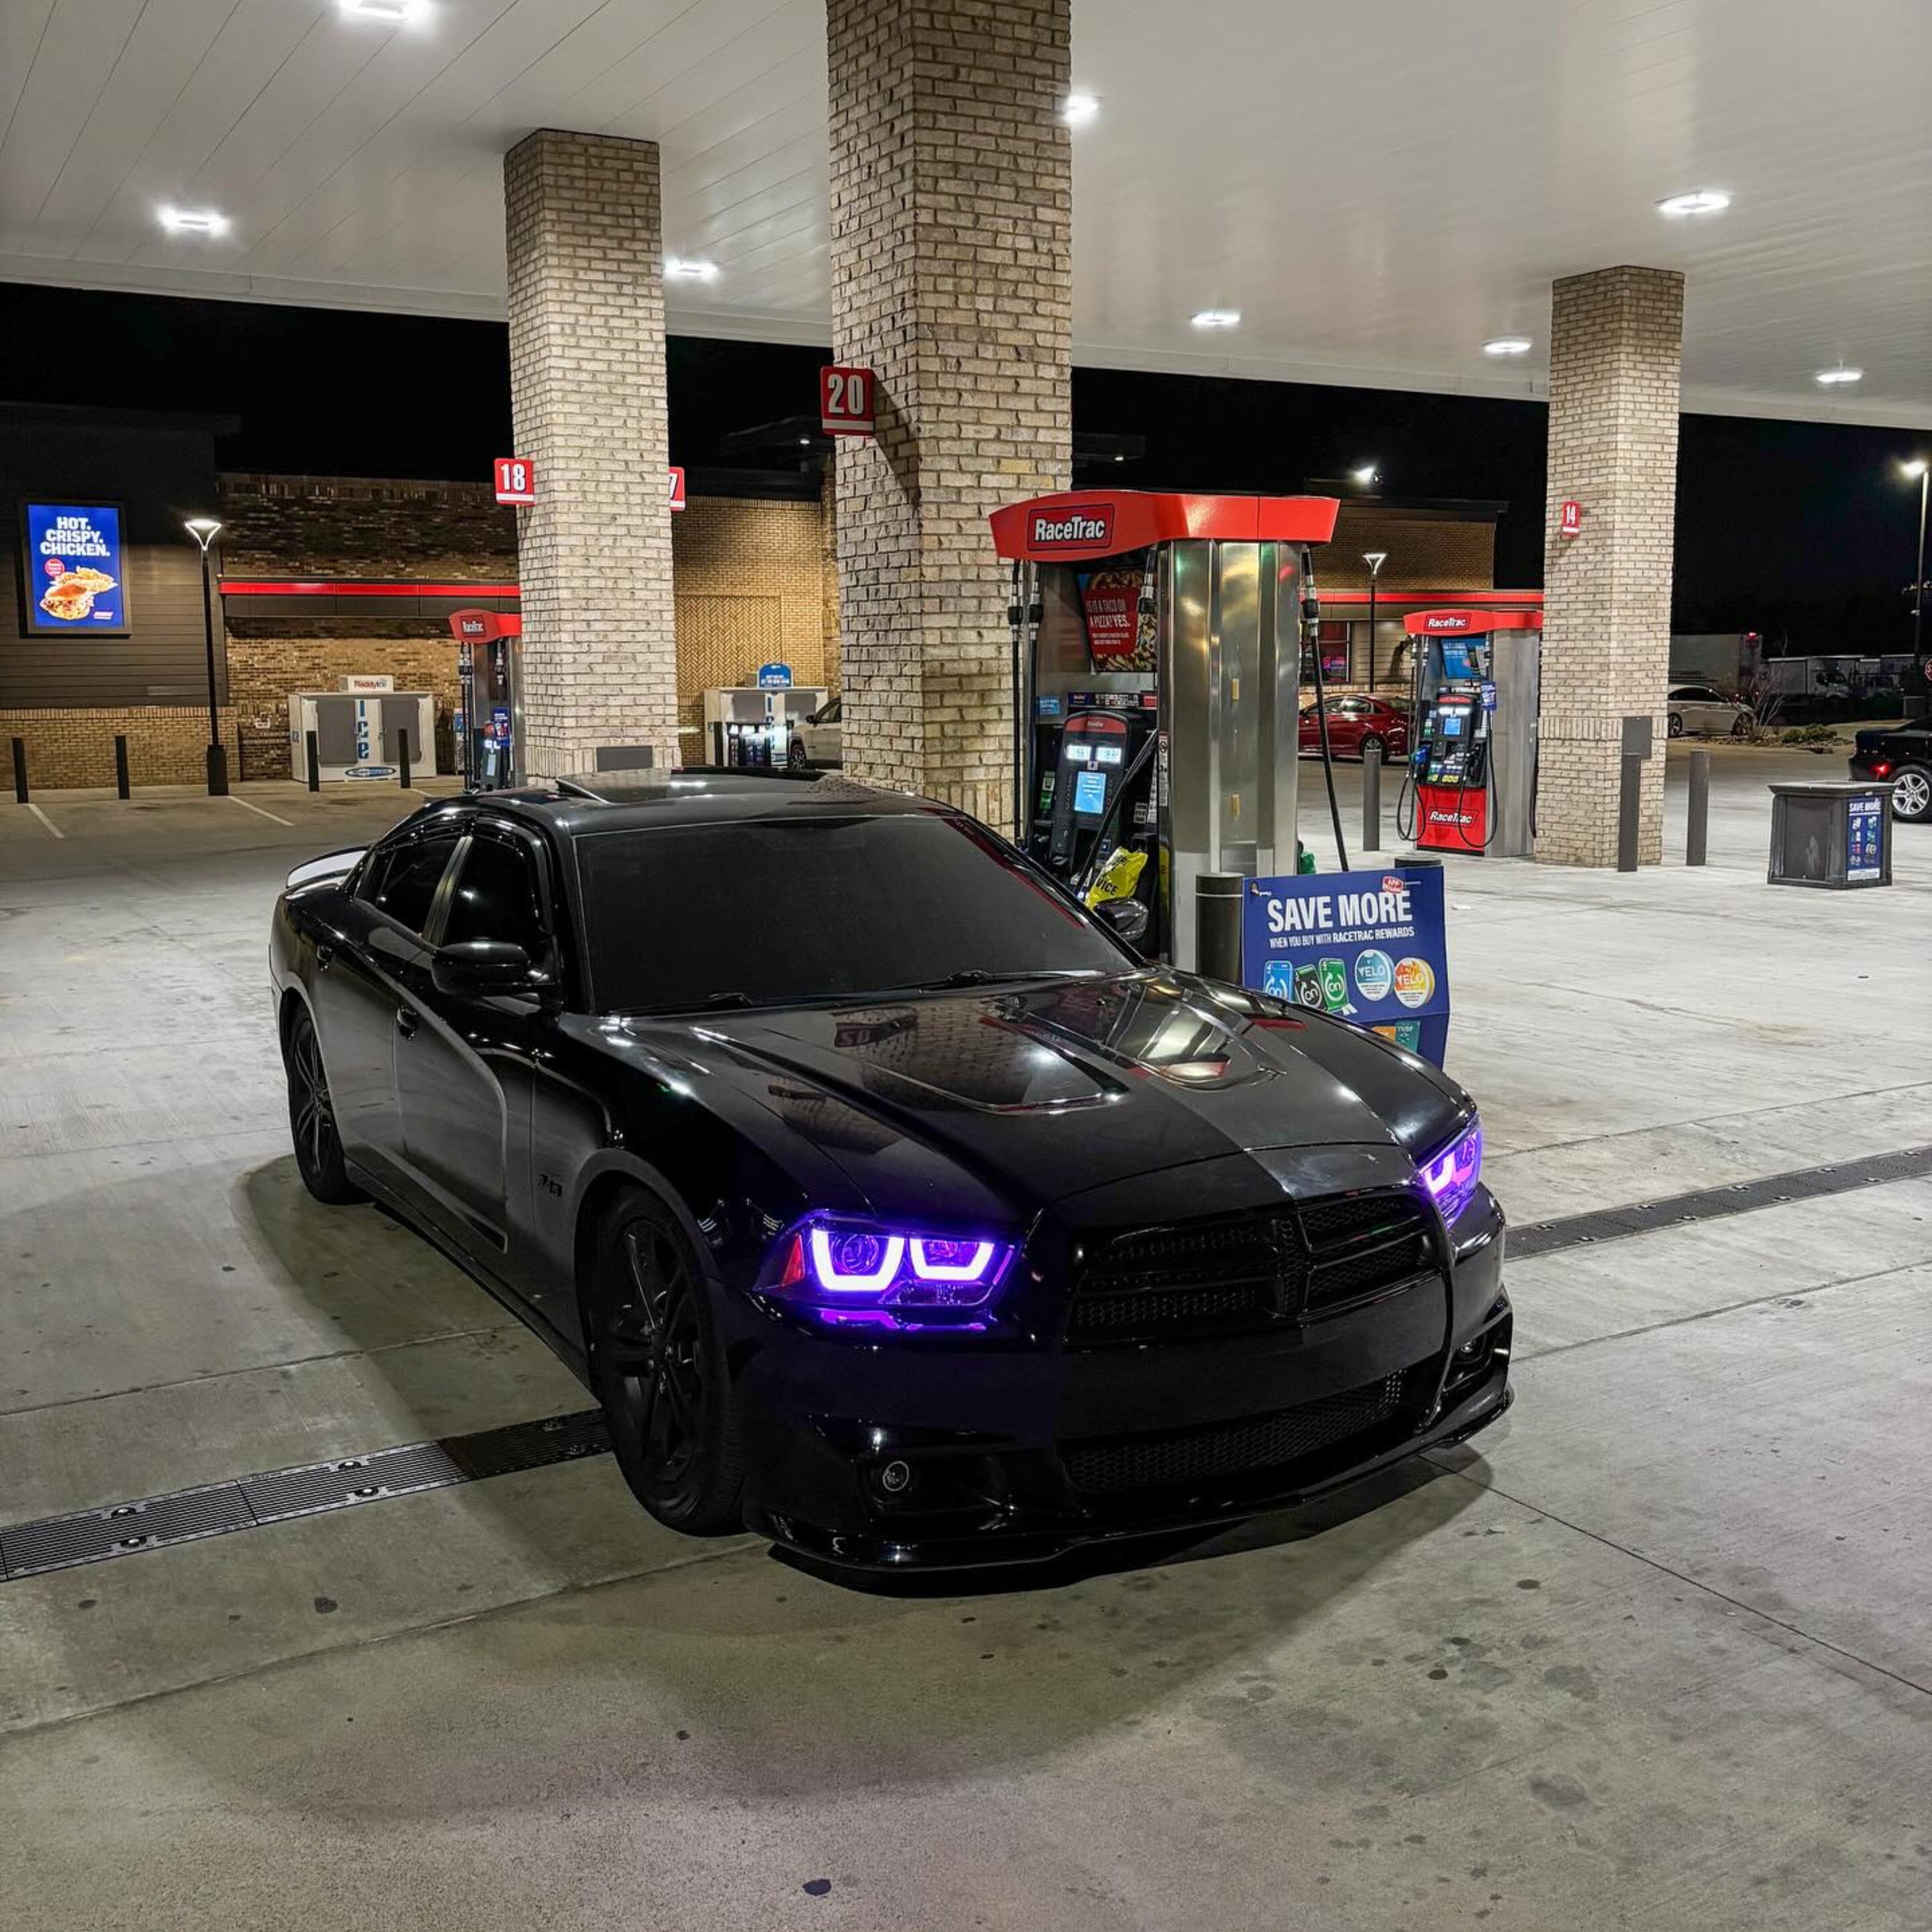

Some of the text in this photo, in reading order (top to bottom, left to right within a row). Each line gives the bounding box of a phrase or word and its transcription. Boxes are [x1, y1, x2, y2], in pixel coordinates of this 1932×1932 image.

[828, 374, 864, 414] 20
[500, 464, 525, 491] 18
[669, 473, 678, 498] 7
[57, 516, 91, 530] HOT.
[1035, 516, 1105, 541] RaceTrac
[45, 529, 104, 543] CRISPY.
[40, 541, 110, 556] CHICKEN.
[1112, 614, 1131, 627] YES.
[1428, 618, 1466, 628] RaceTrac
[1430, 811, 1472, 824] RaceTrac
[1095, 877, 1119, 895] VICE
[1267, 891, 1412, 933] SAVE MORE
[1270, 927, 1415, 949] WHEN YOU BUY WITH RACETRAC REWARDS
